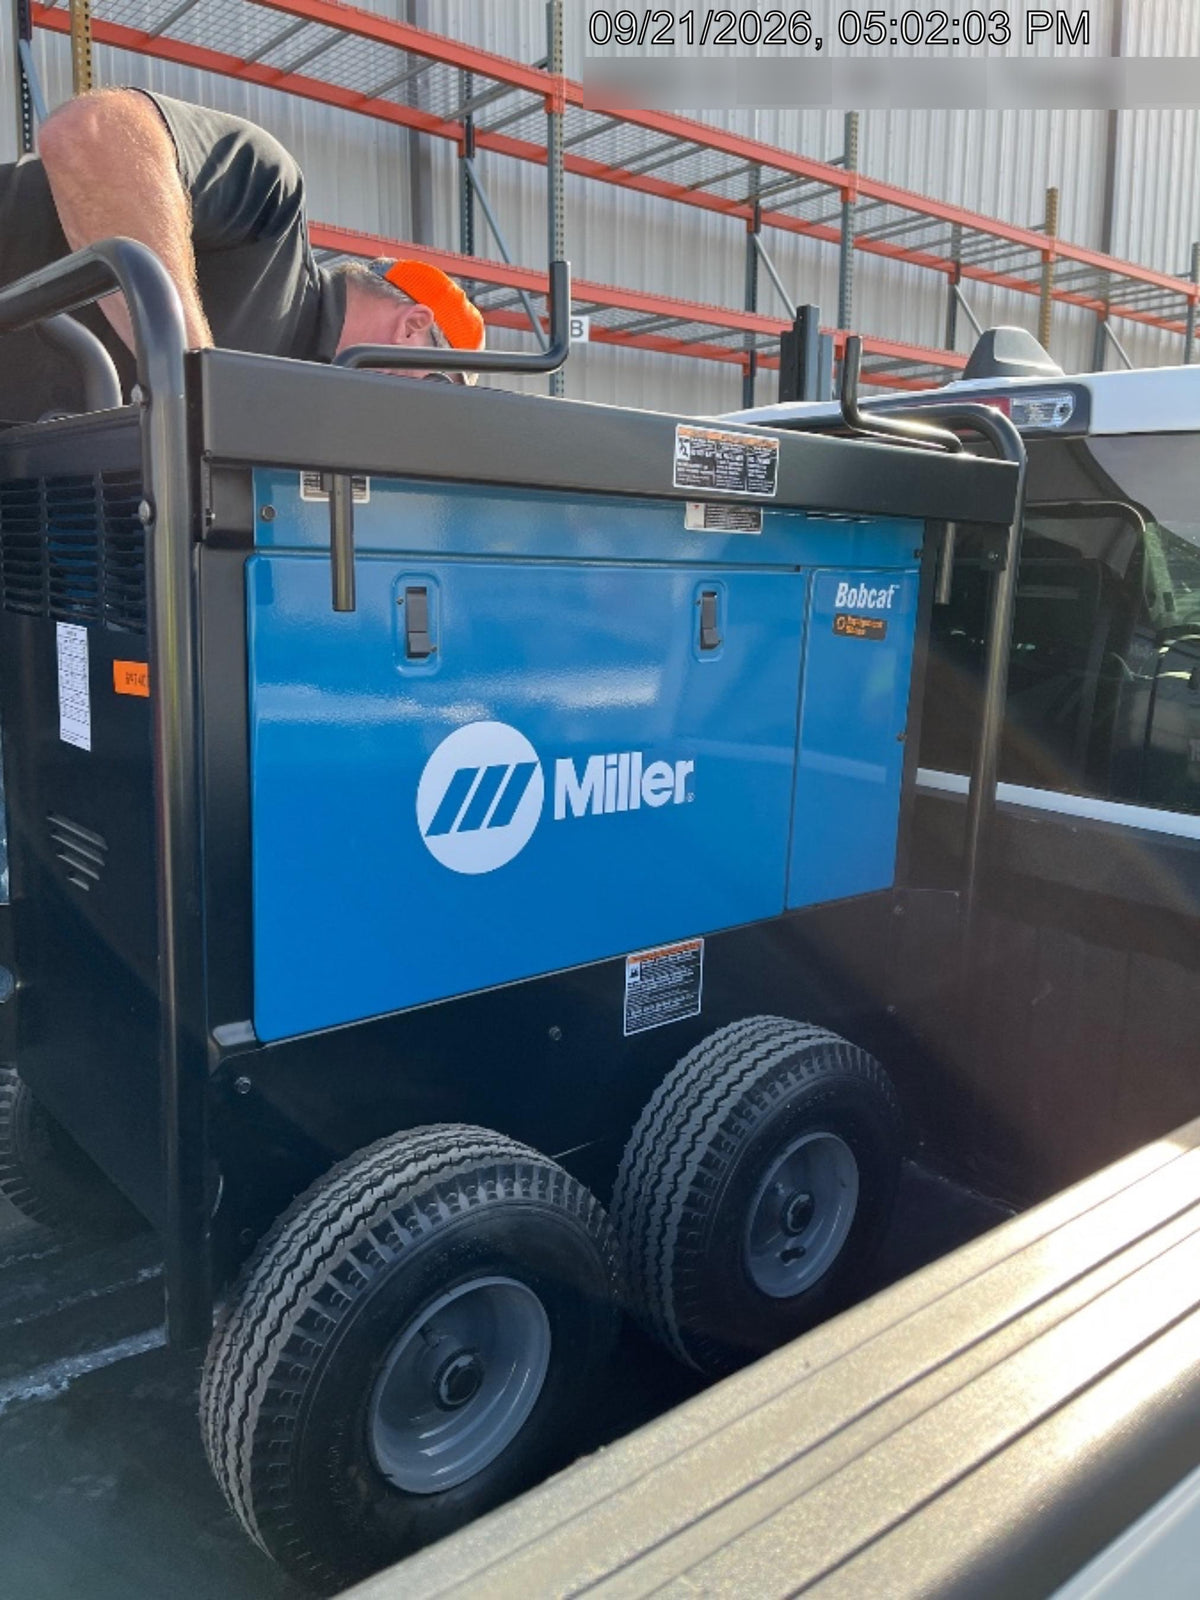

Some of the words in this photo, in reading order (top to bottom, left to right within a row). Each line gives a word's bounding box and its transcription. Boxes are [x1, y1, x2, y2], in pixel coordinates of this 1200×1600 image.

[570, 319, 584, 338] B
[835, 582, 895, 609] Bobcat
[553, 751, 694, 821] Miller
